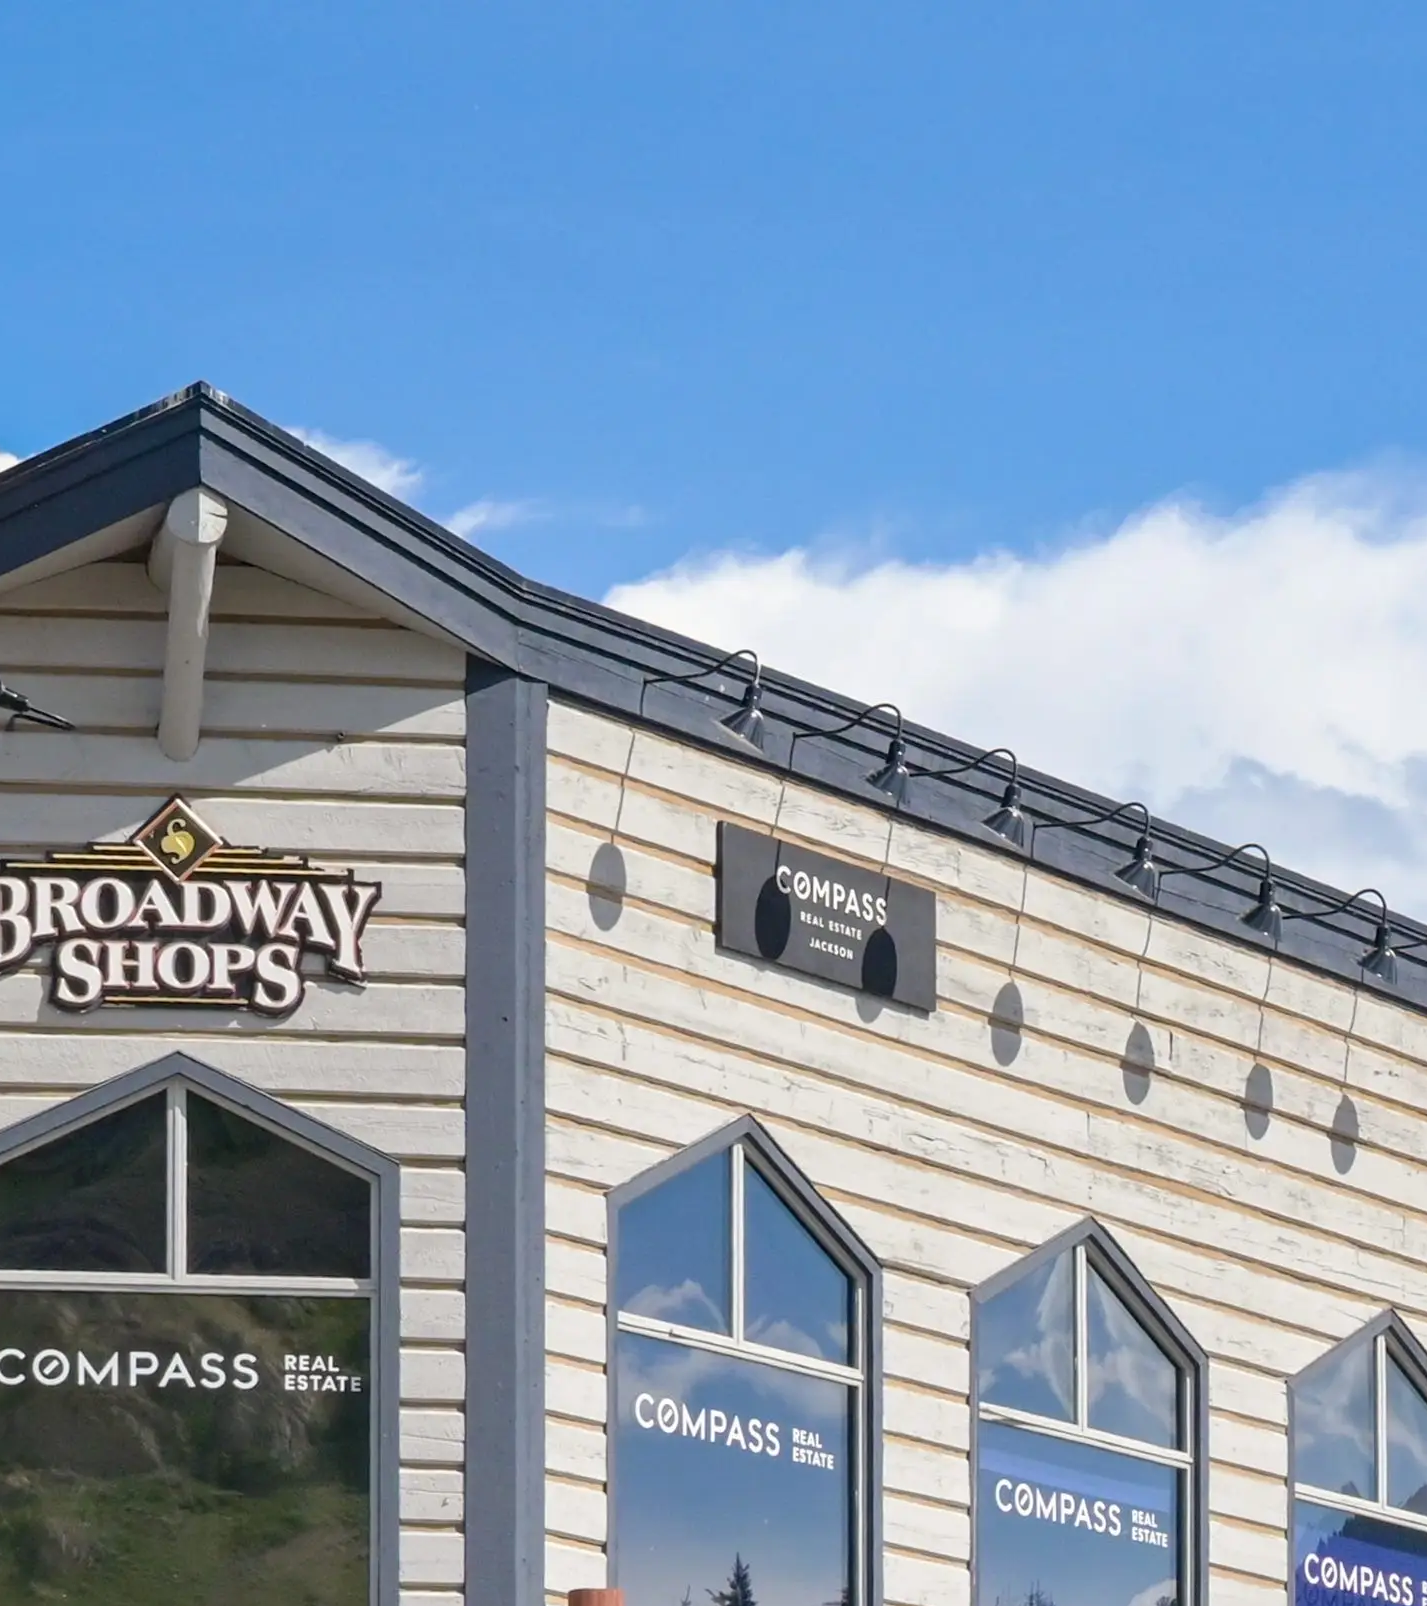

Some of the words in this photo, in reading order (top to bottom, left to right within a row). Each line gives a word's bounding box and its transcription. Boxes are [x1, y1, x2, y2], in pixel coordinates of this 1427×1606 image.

[776, 865, 887, 926] COMPASS
[800, 911, 824, 928] REAL
[828, 920, 862, 941] ESTATE
[809, 937, 854, 960] JACKSON
[57, 937, 301, 1009] SHOPS
[284, 1354, 340, 1373] REAL
[284, 1374, 362, 1393] ESTATE
[635, 1392, 780, 1457] COMPASS
[792, 1427, 823, 1449] REAL
[792, 1447, 834, 1470] ESTATE
[995, 1478, 1122, 1537] COMPASS
[1131, 1509, 1158, 1528] REAL
[1131, 1528, 1168, 1548] ESTATE
[1304, 1553, 1414, 1606] COMPASS
